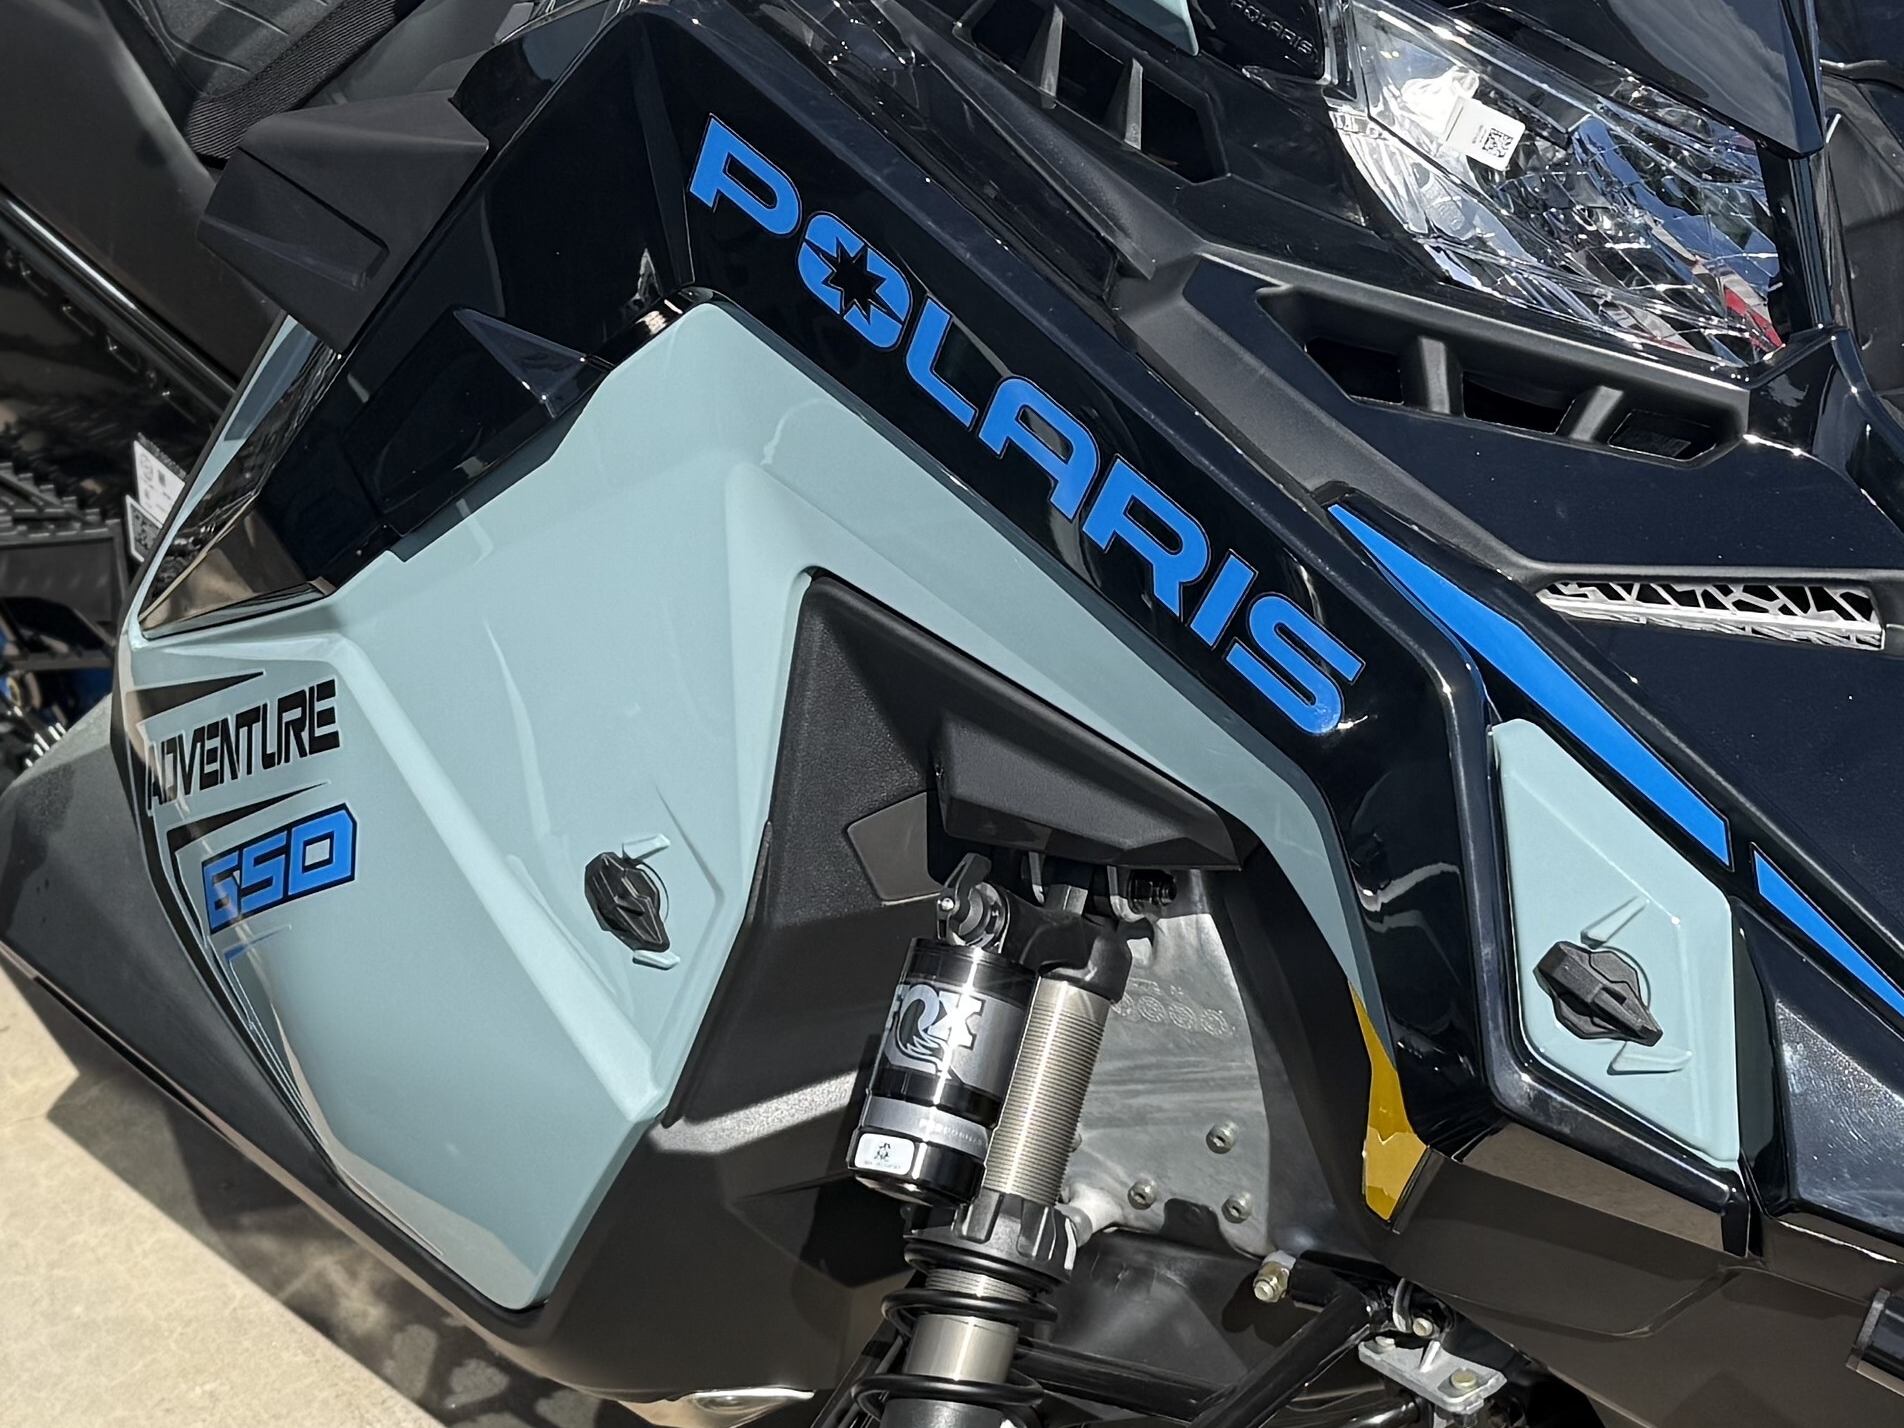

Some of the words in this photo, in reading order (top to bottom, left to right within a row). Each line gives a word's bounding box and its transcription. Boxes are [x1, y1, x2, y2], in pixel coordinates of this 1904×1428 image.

[688, 115, 1366, 736] POLARIS
[144, 678, 341, 816] ADVENTURE
[200, 802, 359, 934] 650
